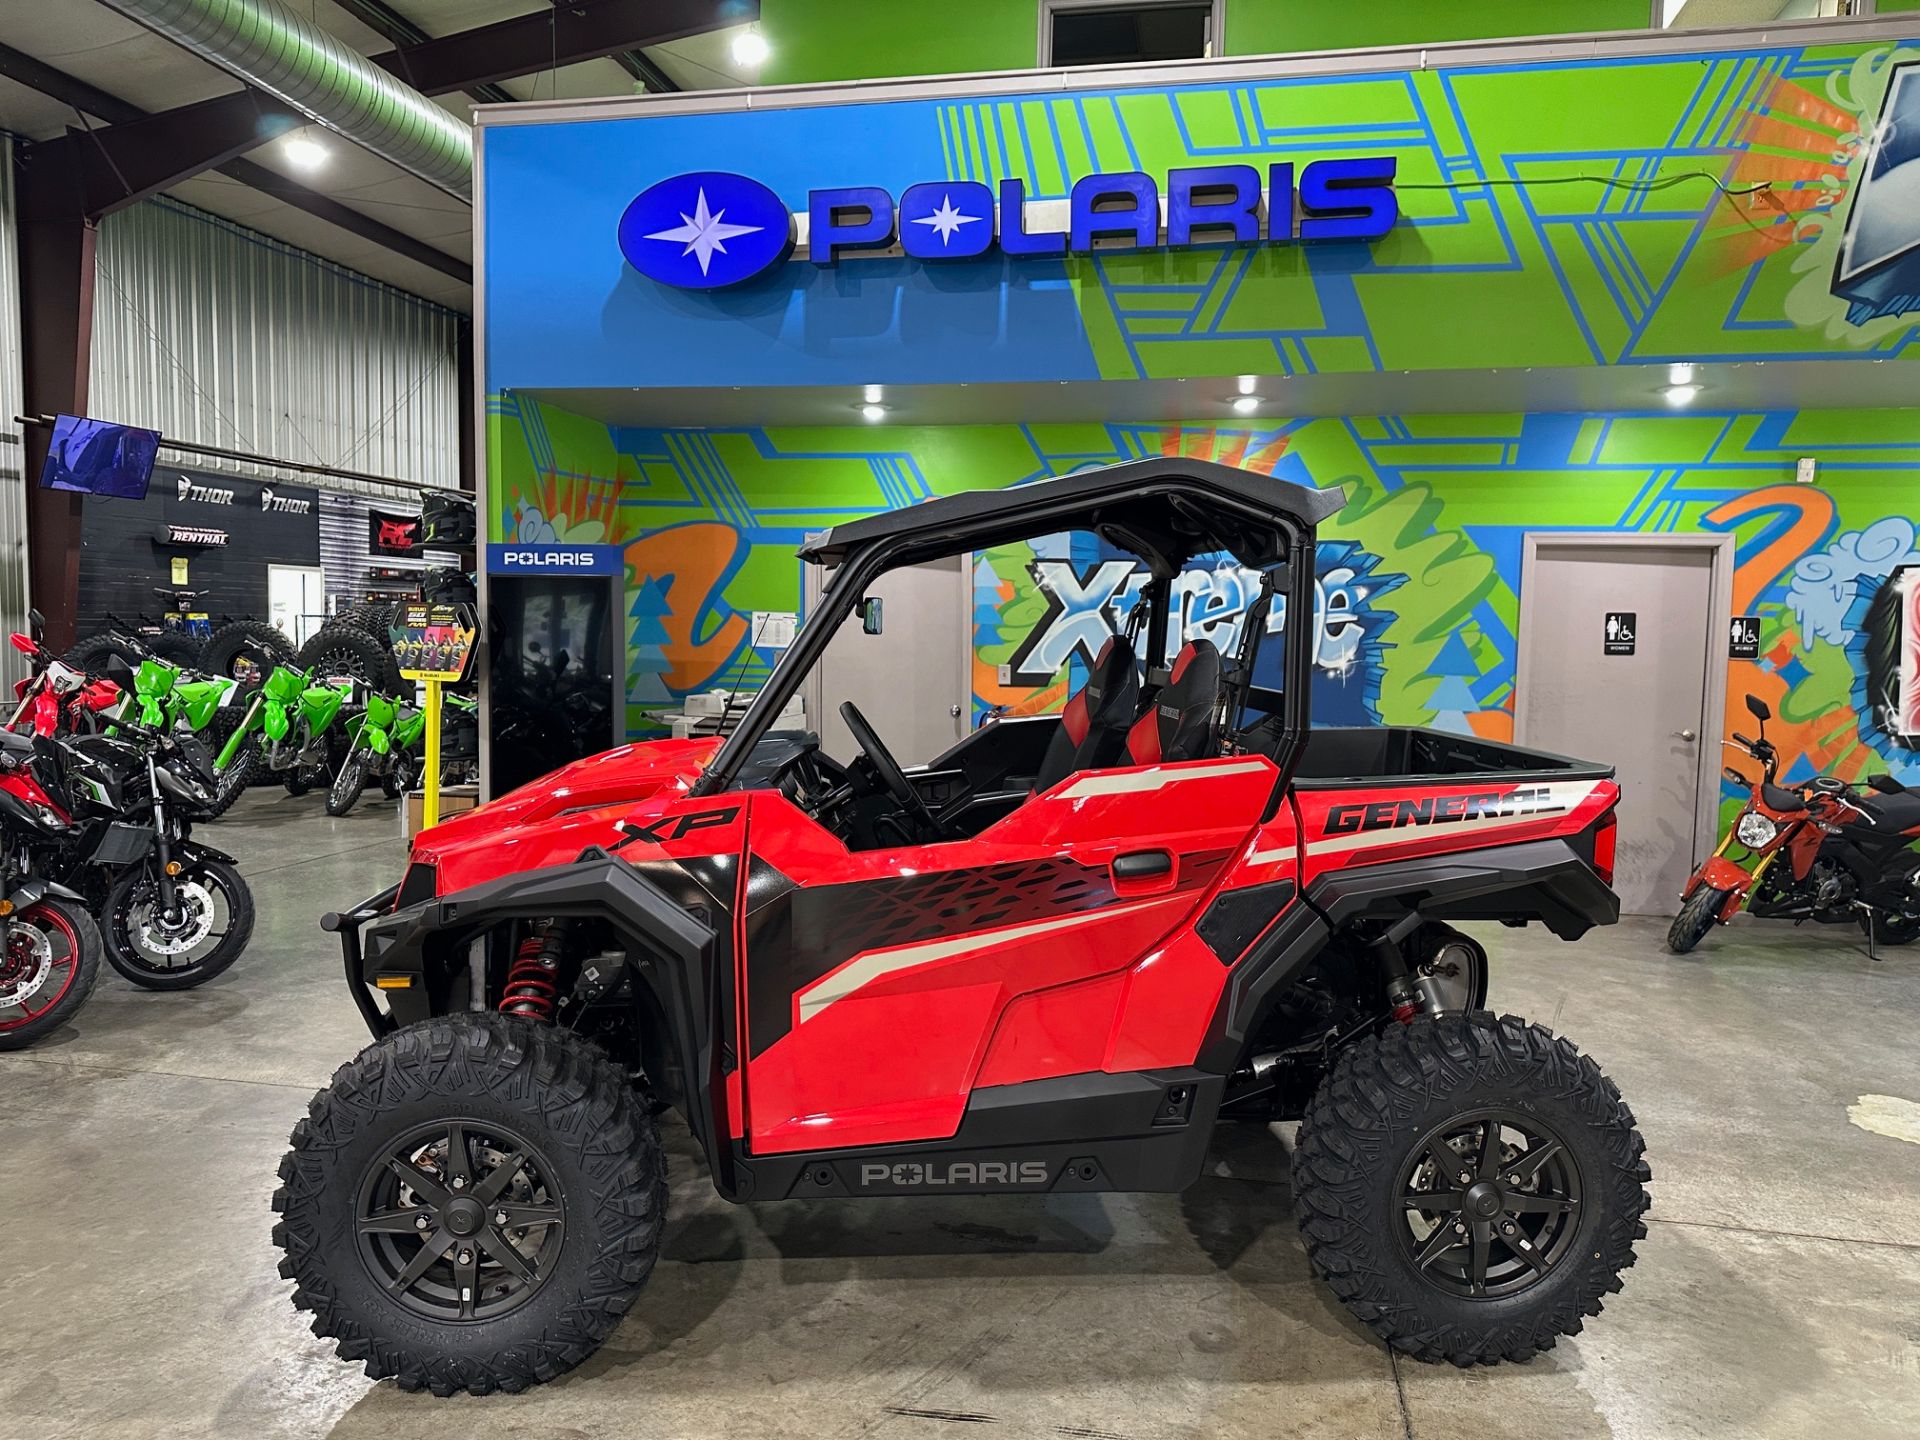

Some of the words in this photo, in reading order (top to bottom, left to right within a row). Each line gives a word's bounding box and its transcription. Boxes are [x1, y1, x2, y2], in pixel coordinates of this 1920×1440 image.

[808, 157, 1398, 268] POLARIS
[190, 485, 234, 505] THOR
[272, 496, 311, 514] THOR
[172, 530, 229, 545] RENTHAL
[503, 551, 594, 566] POLARIS
[1321, 788, 1566, 835] GENERAL
[605, 806, 742, 851] XP
[861, 1161, 1048, 1186] POLARIS
